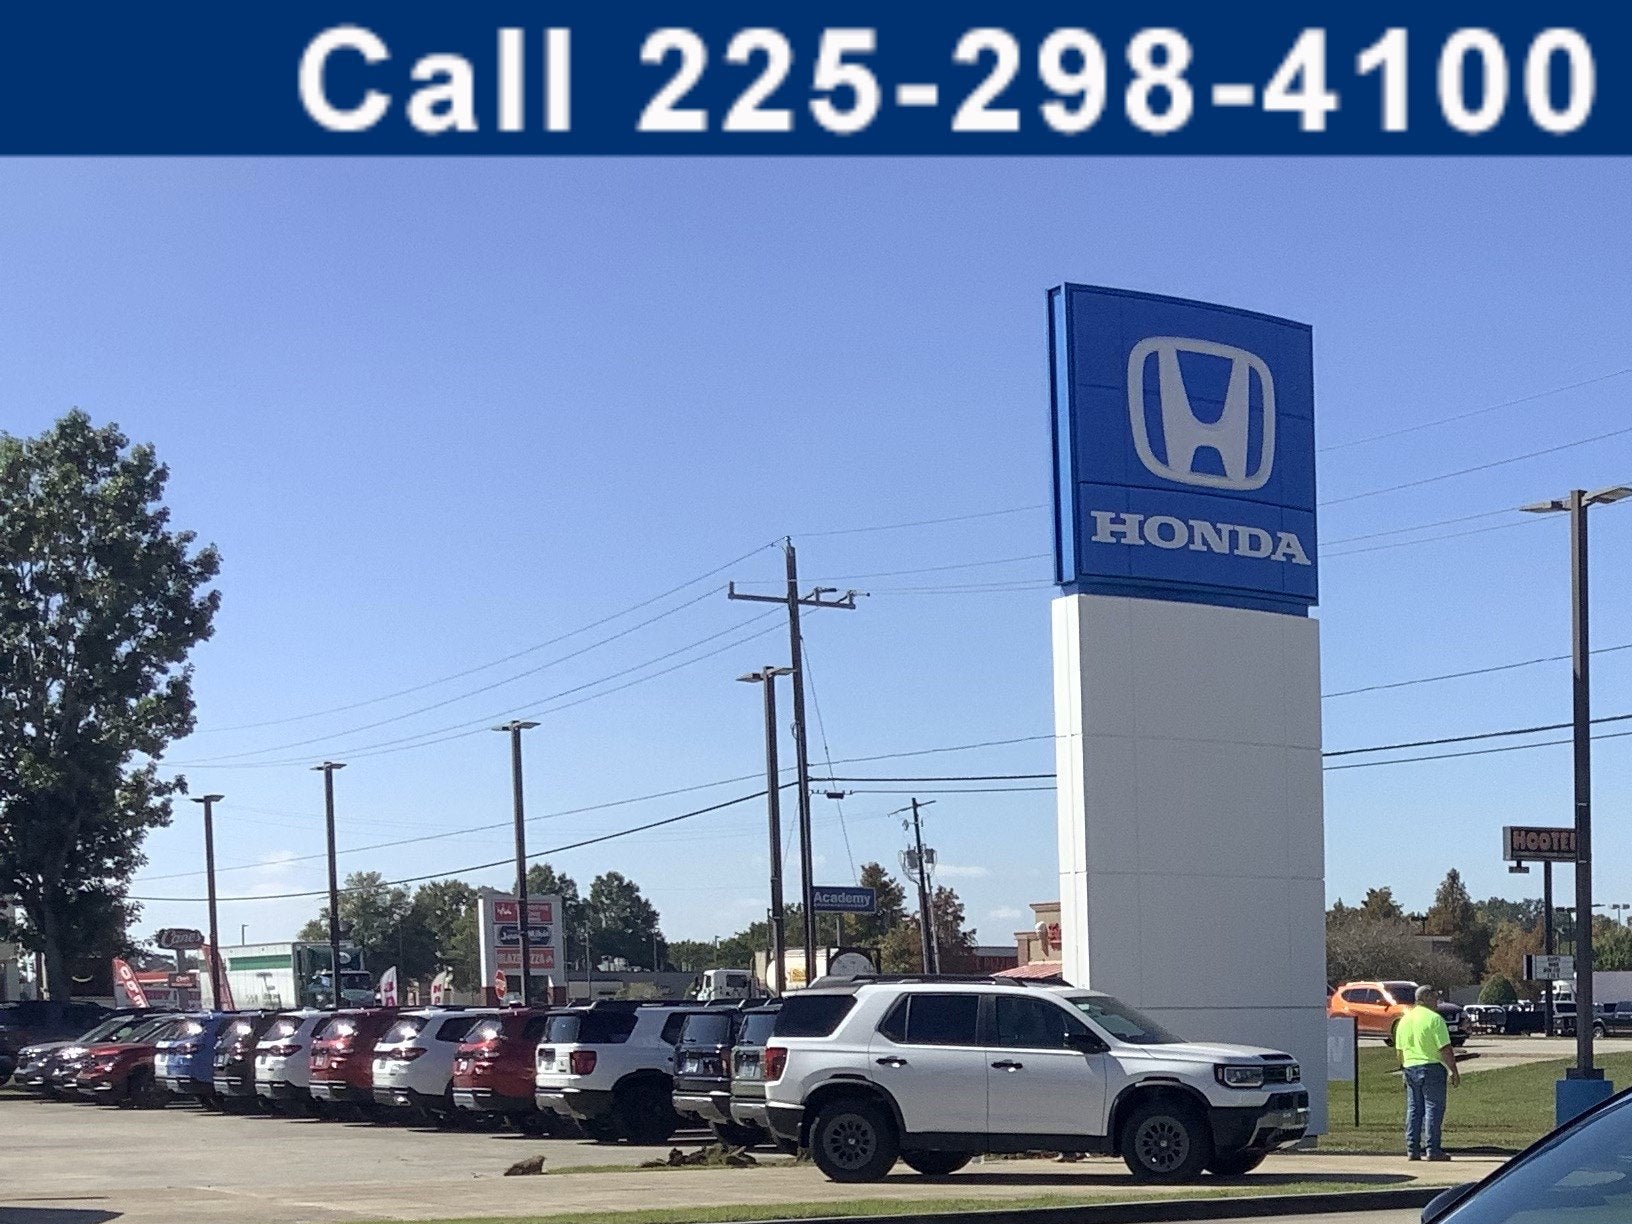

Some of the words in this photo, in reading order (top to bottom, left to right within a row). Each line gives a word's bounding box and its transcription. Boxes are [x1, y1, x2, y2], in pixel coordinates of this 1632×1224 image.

[1091, 510, 1312, 566] HONDA
[1512, 830, 1577, 851] HOOTE
[813, 891, 870, 907] Academy
